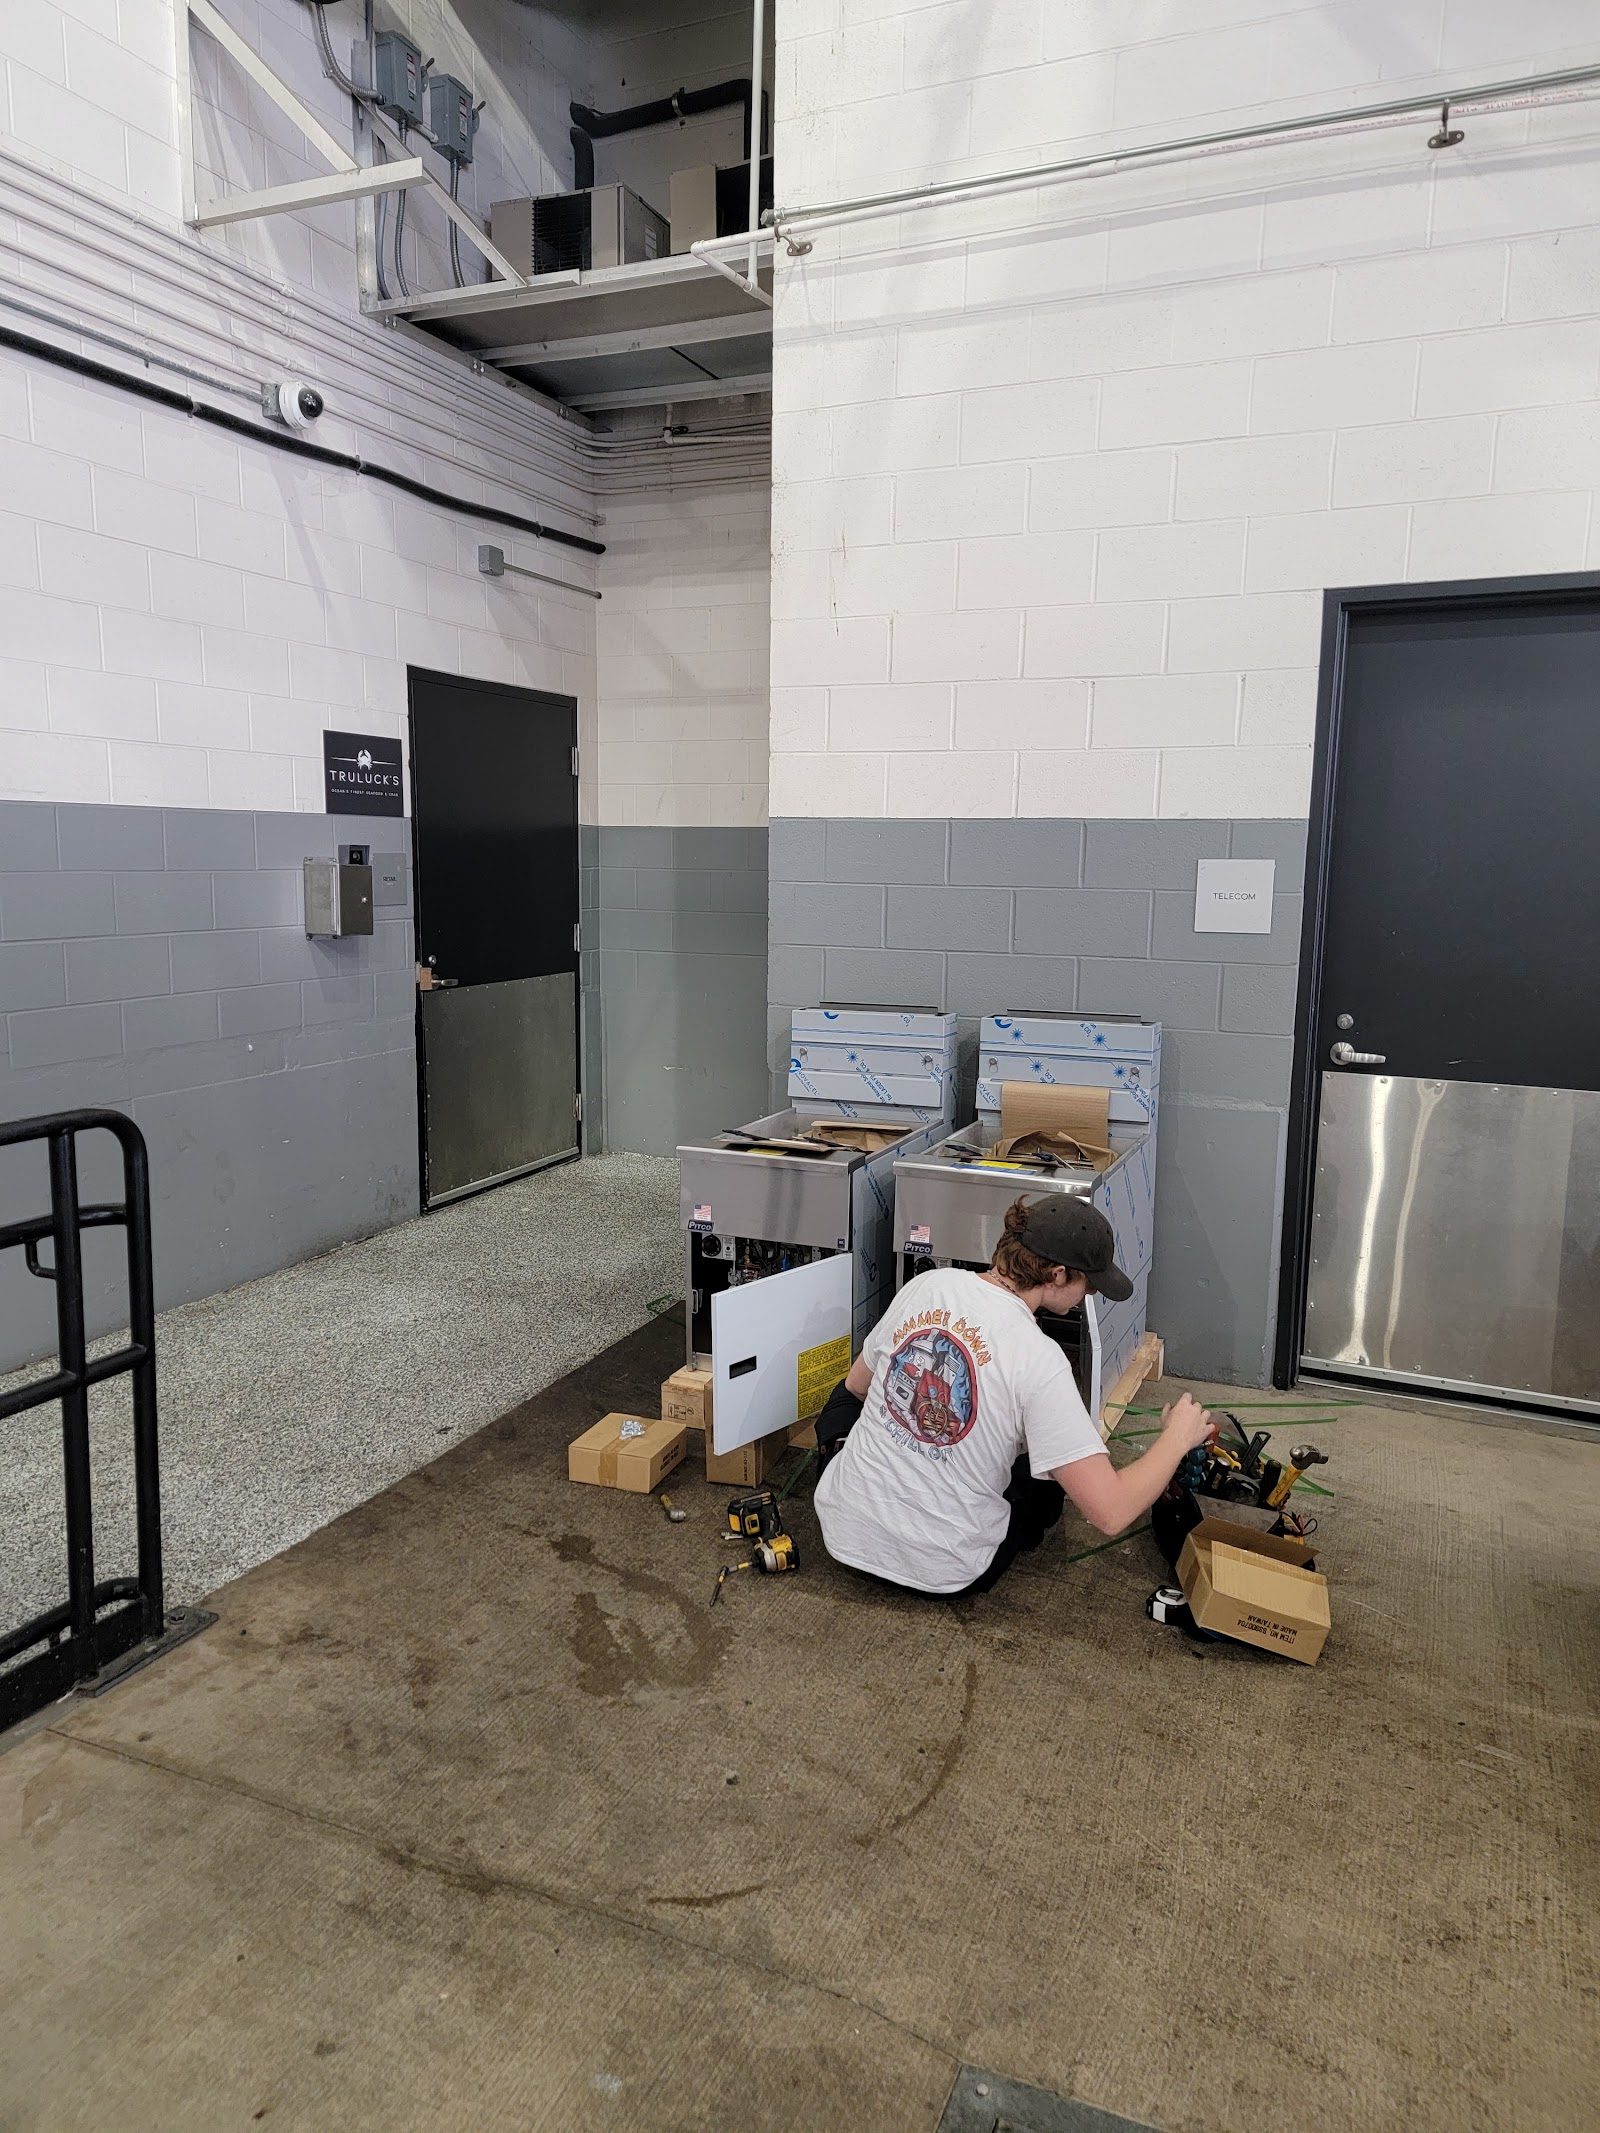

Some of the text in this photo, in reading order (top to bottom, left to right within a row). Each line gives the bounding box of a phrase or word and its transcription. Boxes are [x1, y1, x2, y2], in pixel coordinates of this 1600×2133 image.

[329, 770, 399, 786] TRULUCK'S
[1213, 892, 1256, 901] TELECOM
[688, 1221, 712, 1231] PITCO
[905, 1242, 930, 1253] PITCO
[952, 1317, 992, 1366] DOWN
[1248, 1615, 1271, 1628] TAIWAN
[1280, 1626, 1297, 1636] MADE
[1279, 1634, 1295, 1644] ITEM
